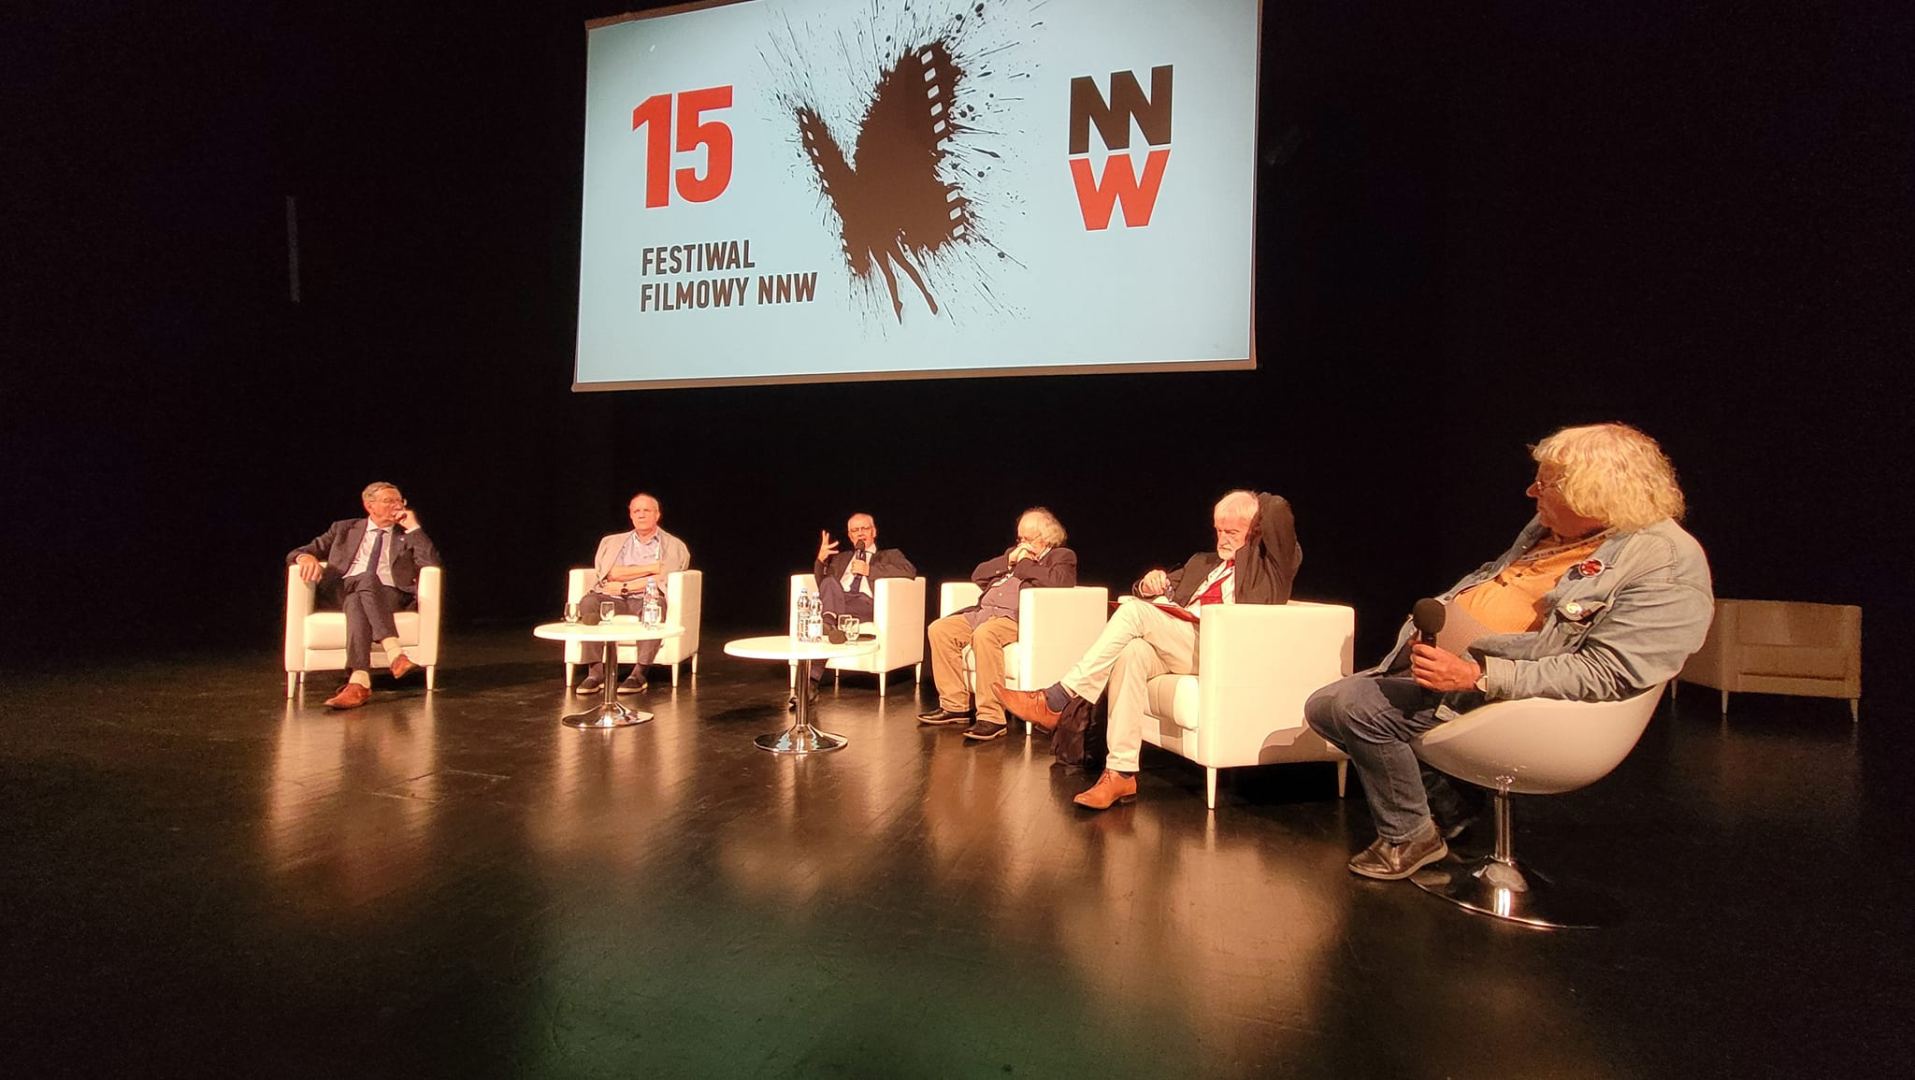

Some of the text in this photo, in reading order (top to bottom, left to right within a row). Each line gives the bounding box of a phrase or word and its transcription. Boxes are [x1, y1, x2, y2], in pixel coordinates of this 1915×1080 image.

[631, 85, 733, 208] 15
[1069, 65, 1173, 154] NN
[1069, 149, 1171, 231] W
[640, 271, 818, 312] FILMOWY NNW
[641, 239, 756, 276] FESTIWAL
